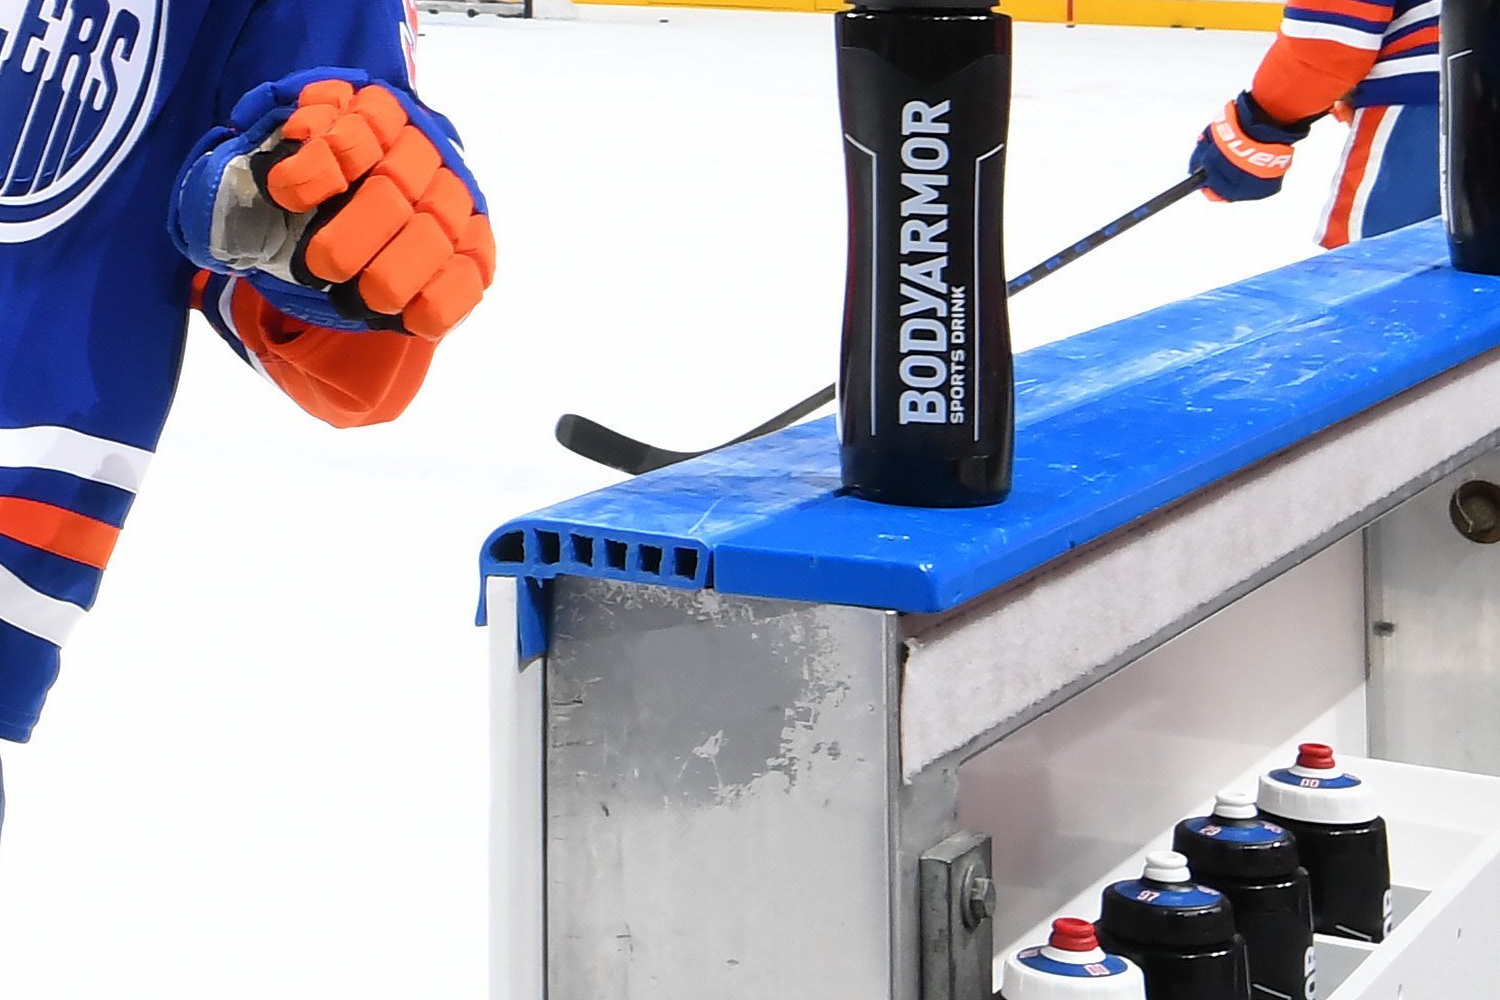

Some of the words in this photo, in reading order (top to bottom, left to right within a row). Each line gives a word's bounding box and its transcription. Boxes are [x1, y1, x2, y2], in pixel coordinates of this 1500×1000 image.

[899, 99, 951, 424] BODYARMOR
[950, 286, 966, 344] DRINK
[950, 349, 965, 424] SPORTS
